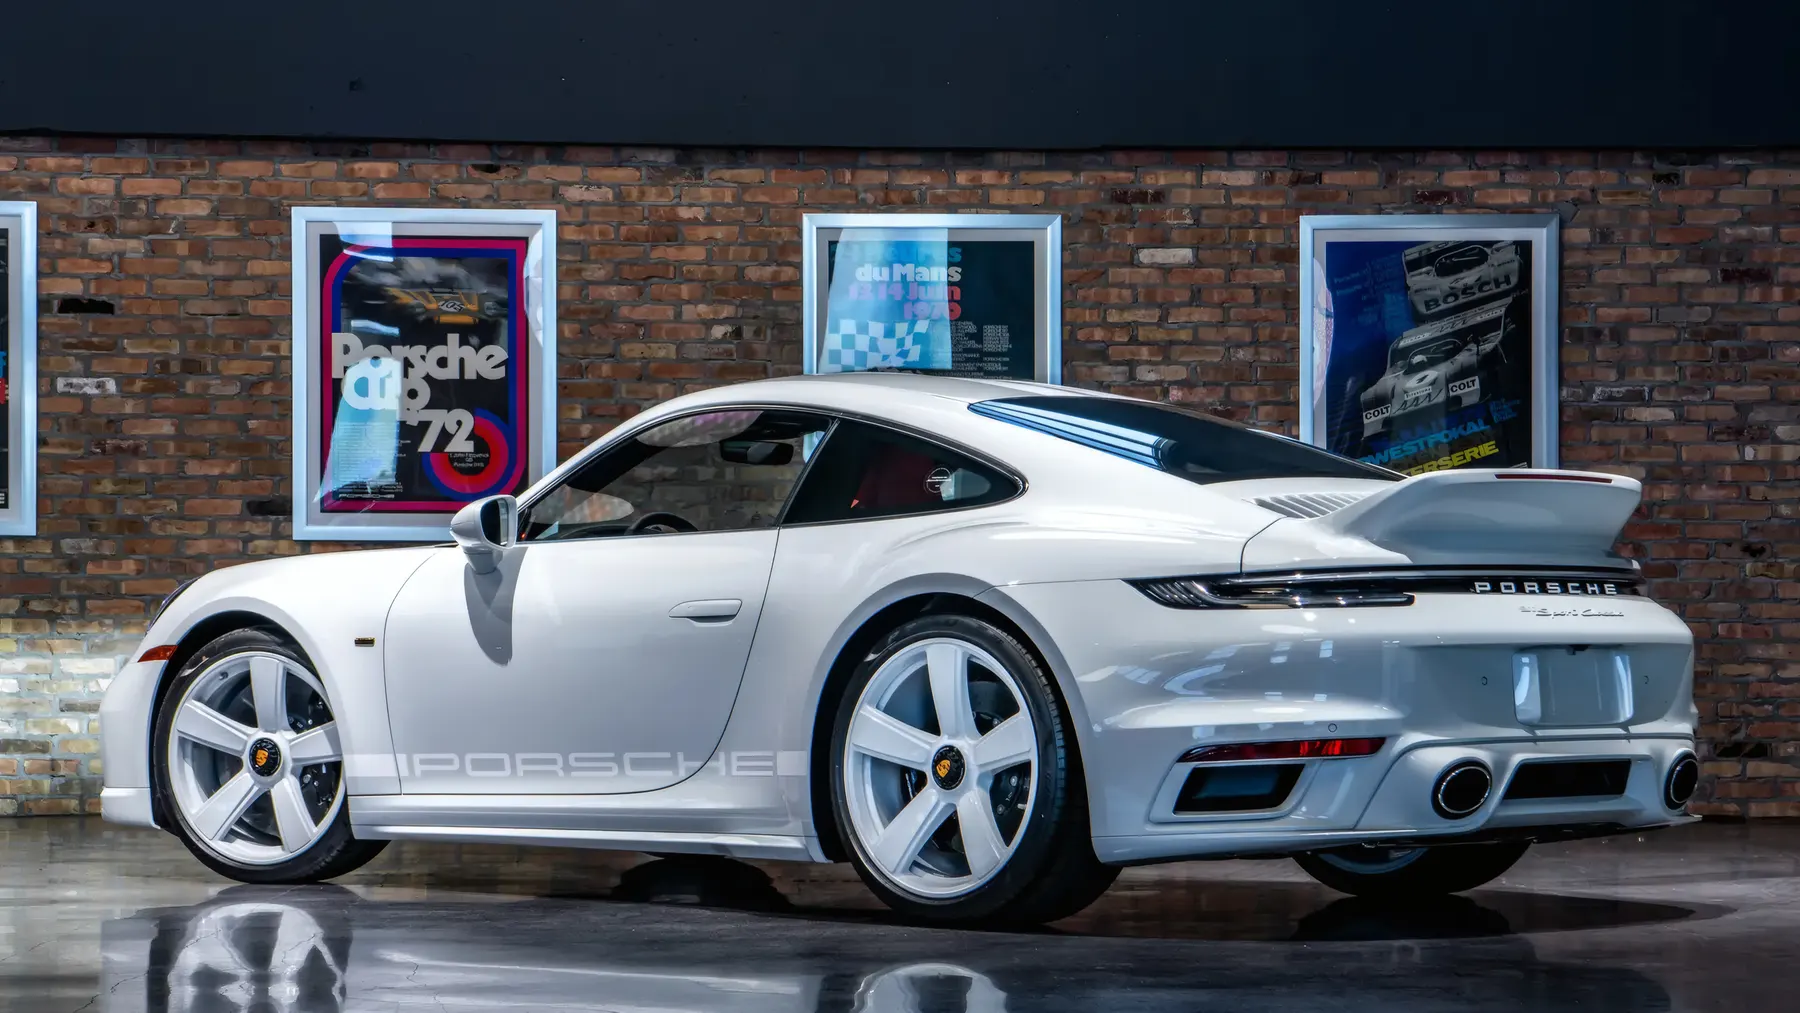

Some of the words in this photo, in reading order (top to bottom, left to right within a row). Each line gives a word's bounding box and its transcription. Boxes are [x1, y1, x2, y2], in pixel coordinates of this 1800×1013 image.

[855, 263, 890, 281] du
[892, 263, 962, 282] Mans
[879, 282, 905, 301] 14
[907, 282, 960, 301] Juin
[1424, 274, 1511, 312] BOSCH
[903, 301, 962, 320] 1970
[332, 333, 508, 380] Porsche
[1450, 379, 1477, 393] COLT
[1364, 405, 1390, 420] COLT
[1474, 581, 1618, 595] PORSCHE
[412, 750, 774, 778] PORSCHE
